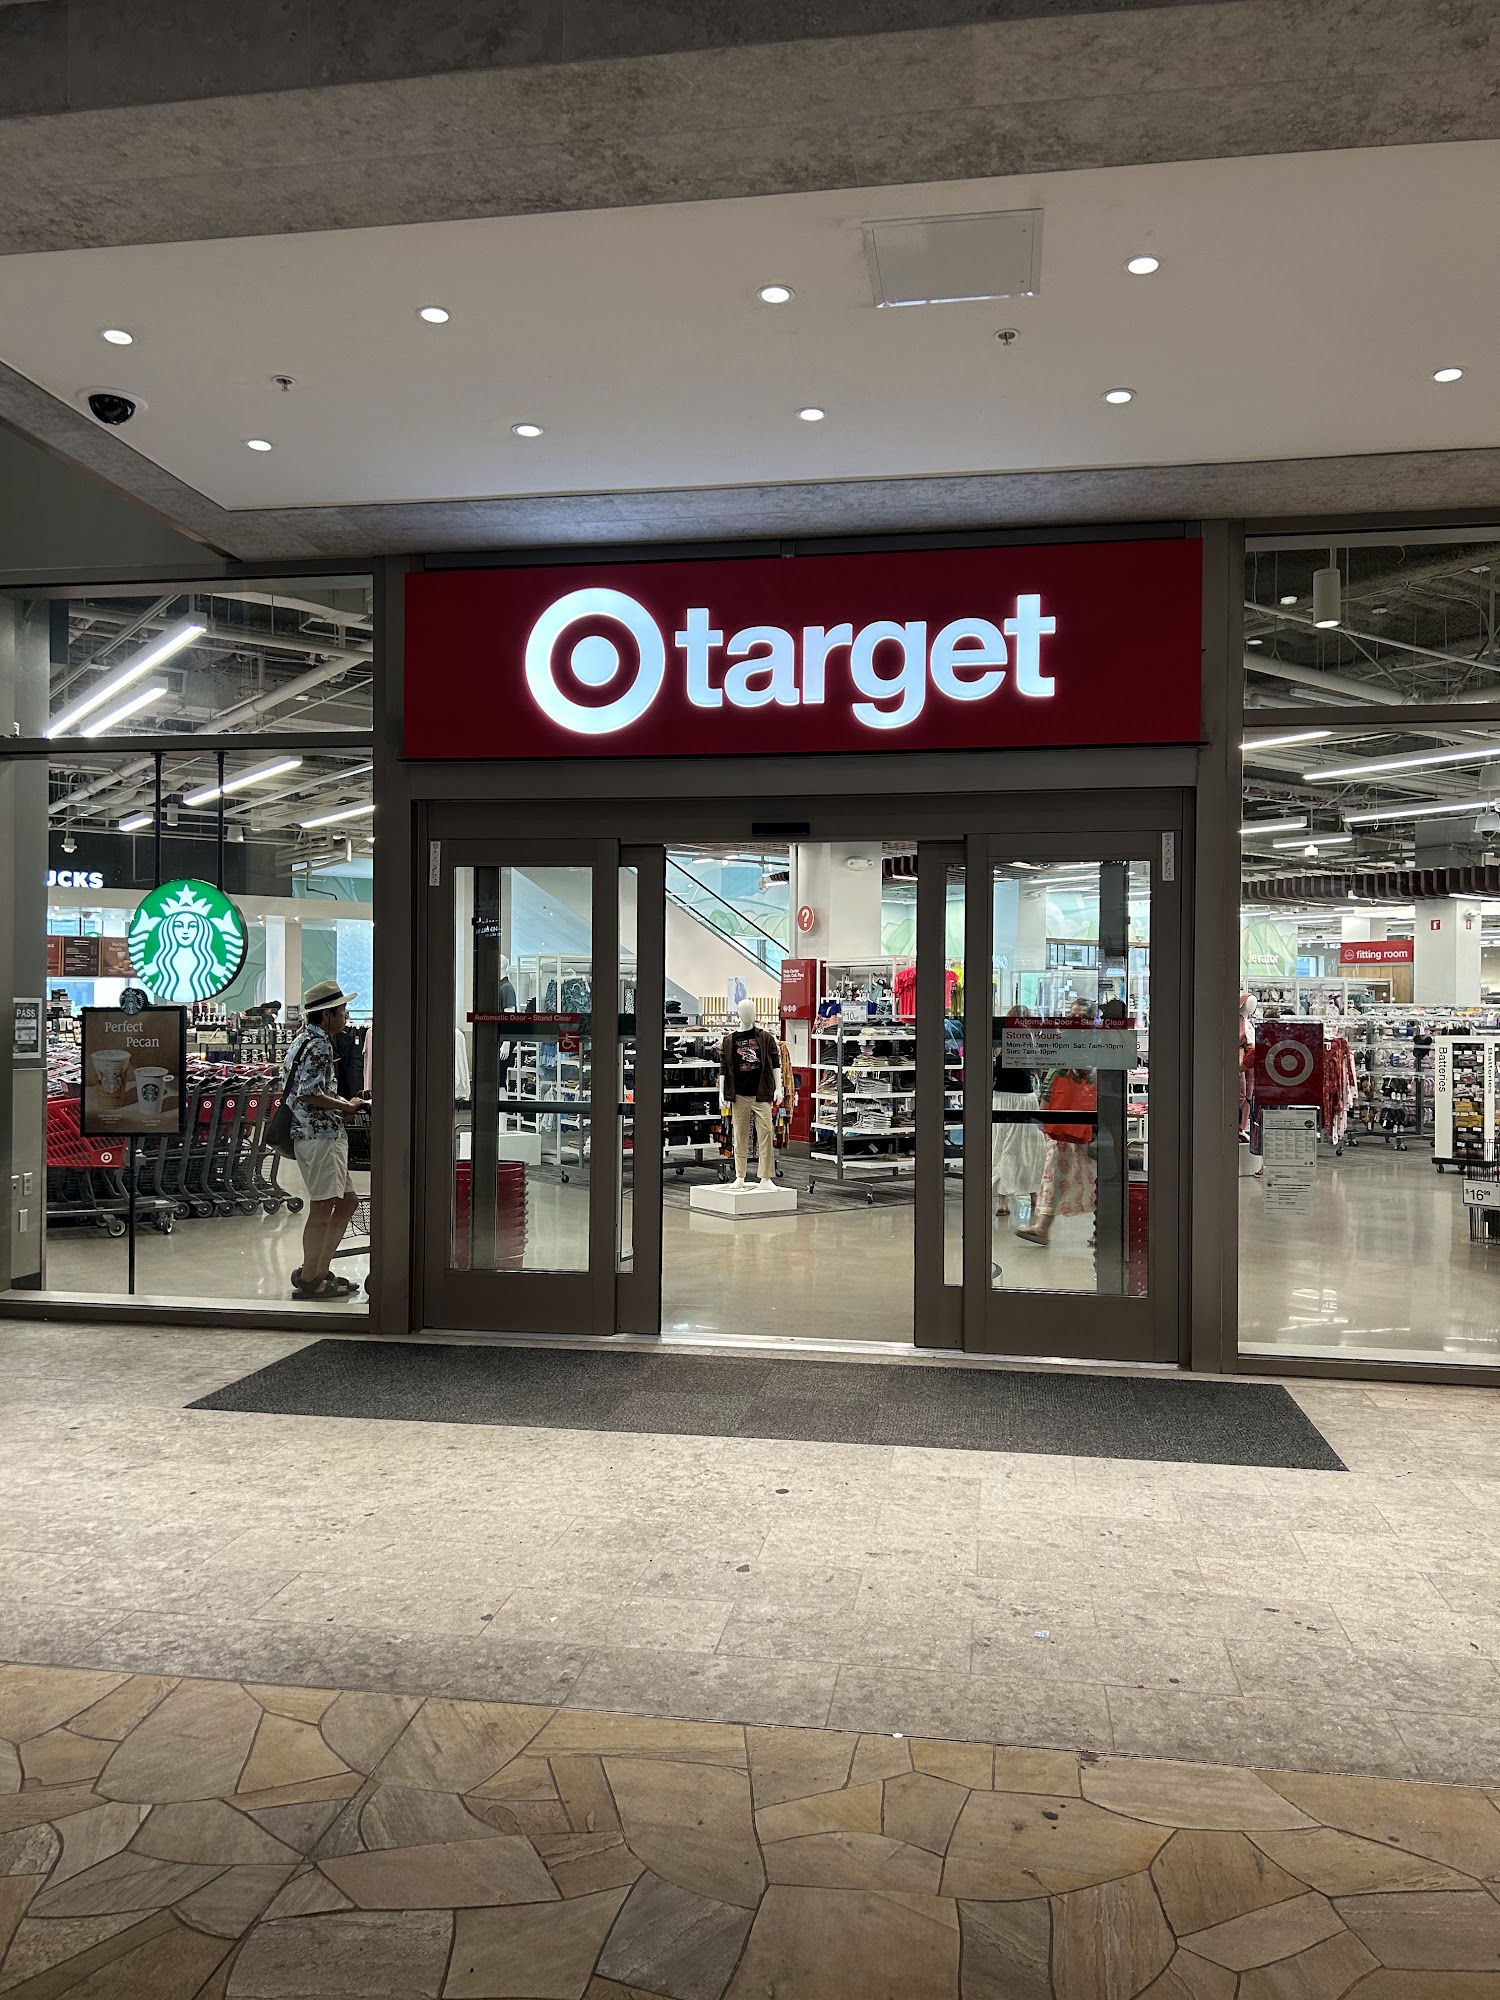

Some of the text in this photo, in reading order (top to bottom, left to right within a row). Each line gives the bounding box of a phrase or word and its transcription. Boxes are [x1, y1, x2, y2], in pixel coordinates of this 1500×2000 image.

[674, 593, 1057, 729] target
[1356, 950, 1408, 960] fitting room
[16, 1008, 36, 1018] PASS
[104, 1020, 144, 1033] Perfect
[1006, 1031, 1061, 1040] Store Hours
[126, 1036, 160, 1048] Pecan
[1035, 1042, 1069, 1050] 7am-10pm
[1438, 1047, 1448, 1093] Batteries
